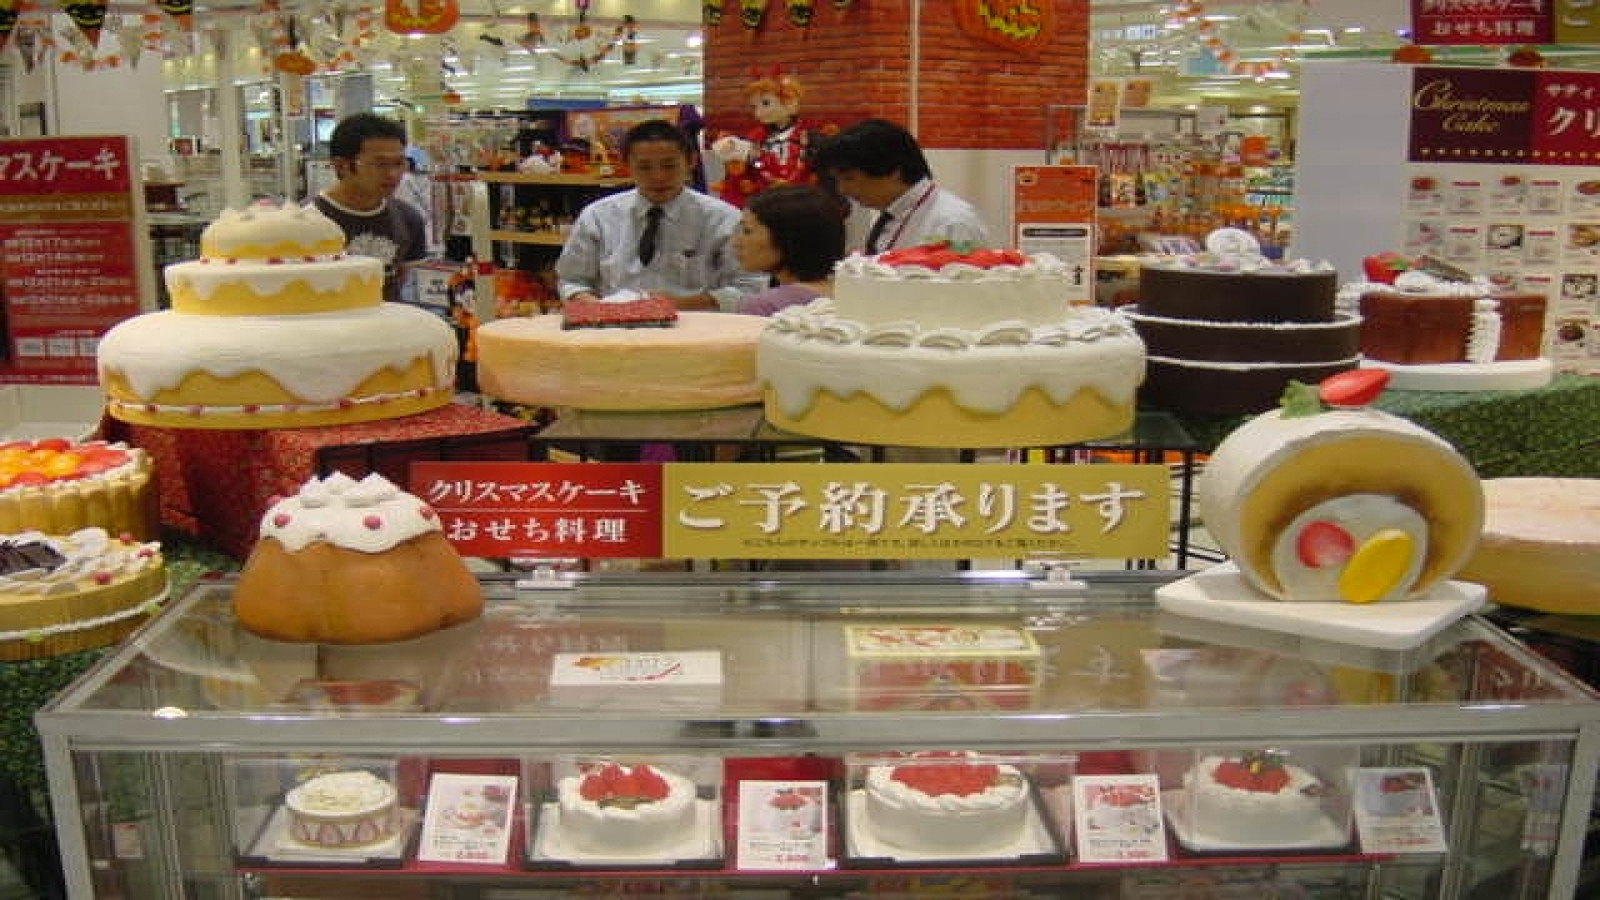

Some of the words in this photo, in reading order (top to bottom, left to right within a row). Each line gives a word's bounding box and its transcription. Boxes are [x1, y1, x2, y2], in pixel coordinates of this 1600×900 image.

[429, 479, 647, 504] クリスマスケーキ
[678, 481, 1145, 535] ご予約承ります
[447, 517, 628, 543] おせち料理
